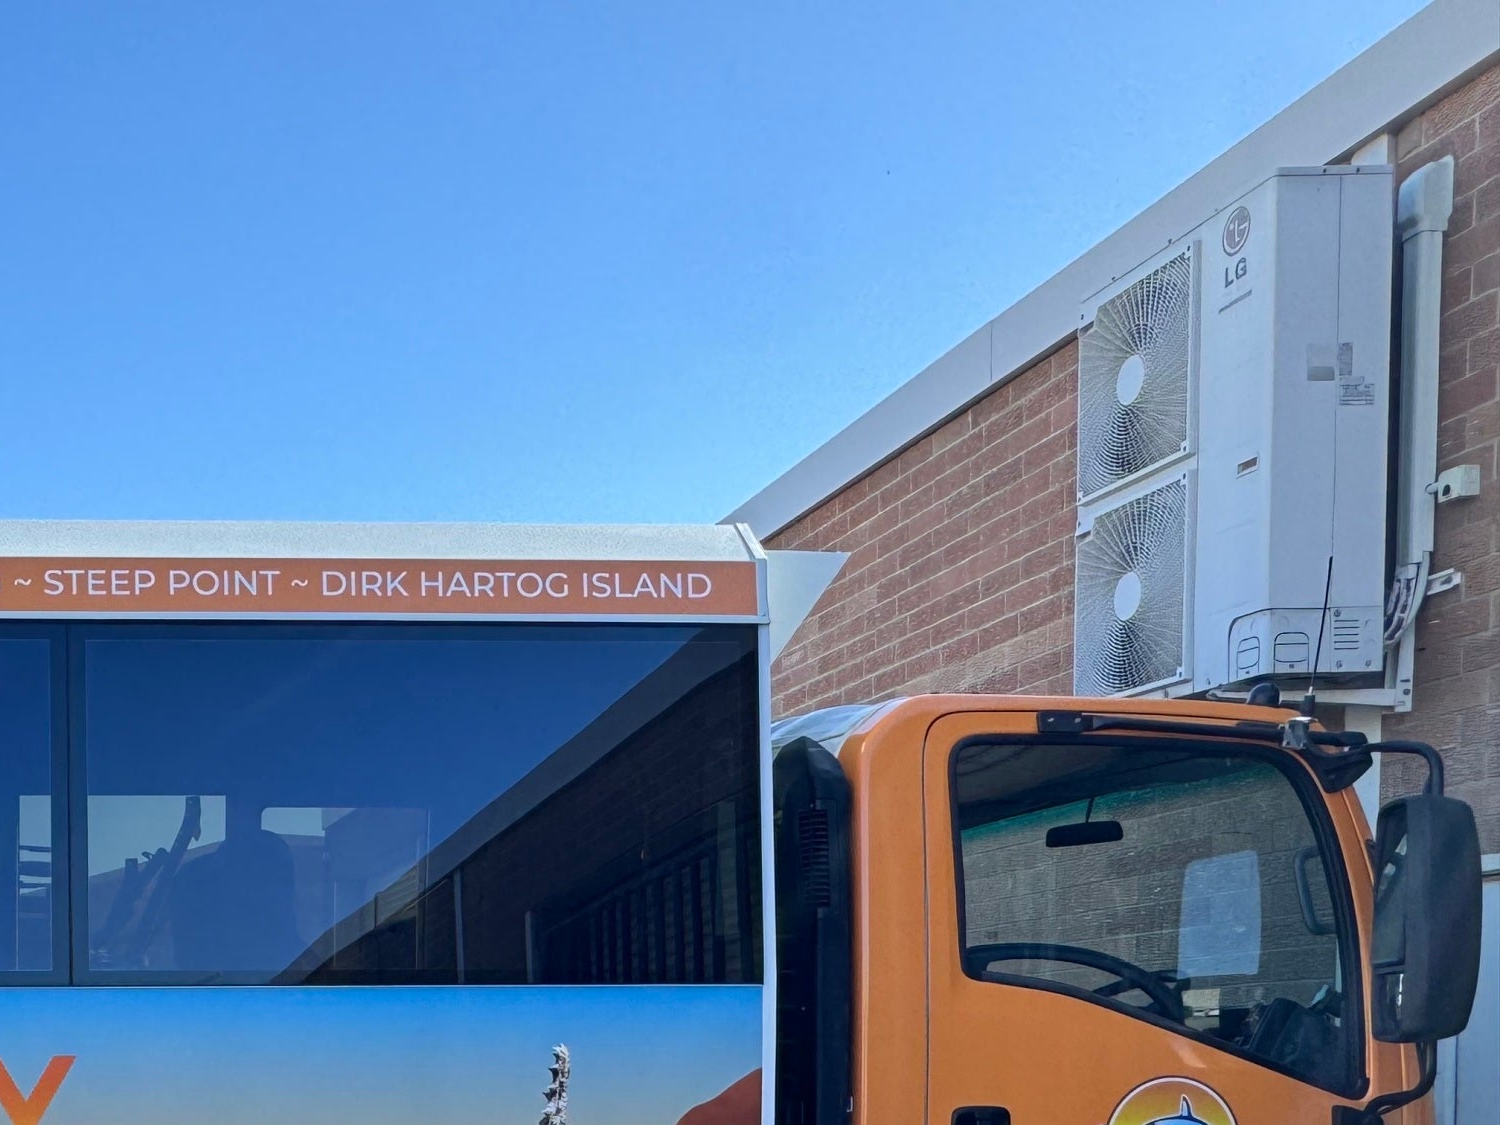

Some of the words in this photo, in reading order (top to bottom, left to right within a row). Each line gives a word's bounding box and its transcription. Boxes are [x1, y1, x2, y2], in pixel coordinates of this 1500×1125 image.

[1224, 257, 1248, 288] LG
[43, 569, 156, 596] STEEP
[168, 569, 281, 596] POINT
[321, 570, 410, 597] DIRK
[420, 571, 569, 599] HARTOG
[582, 572, 713, 600] ISLAND
